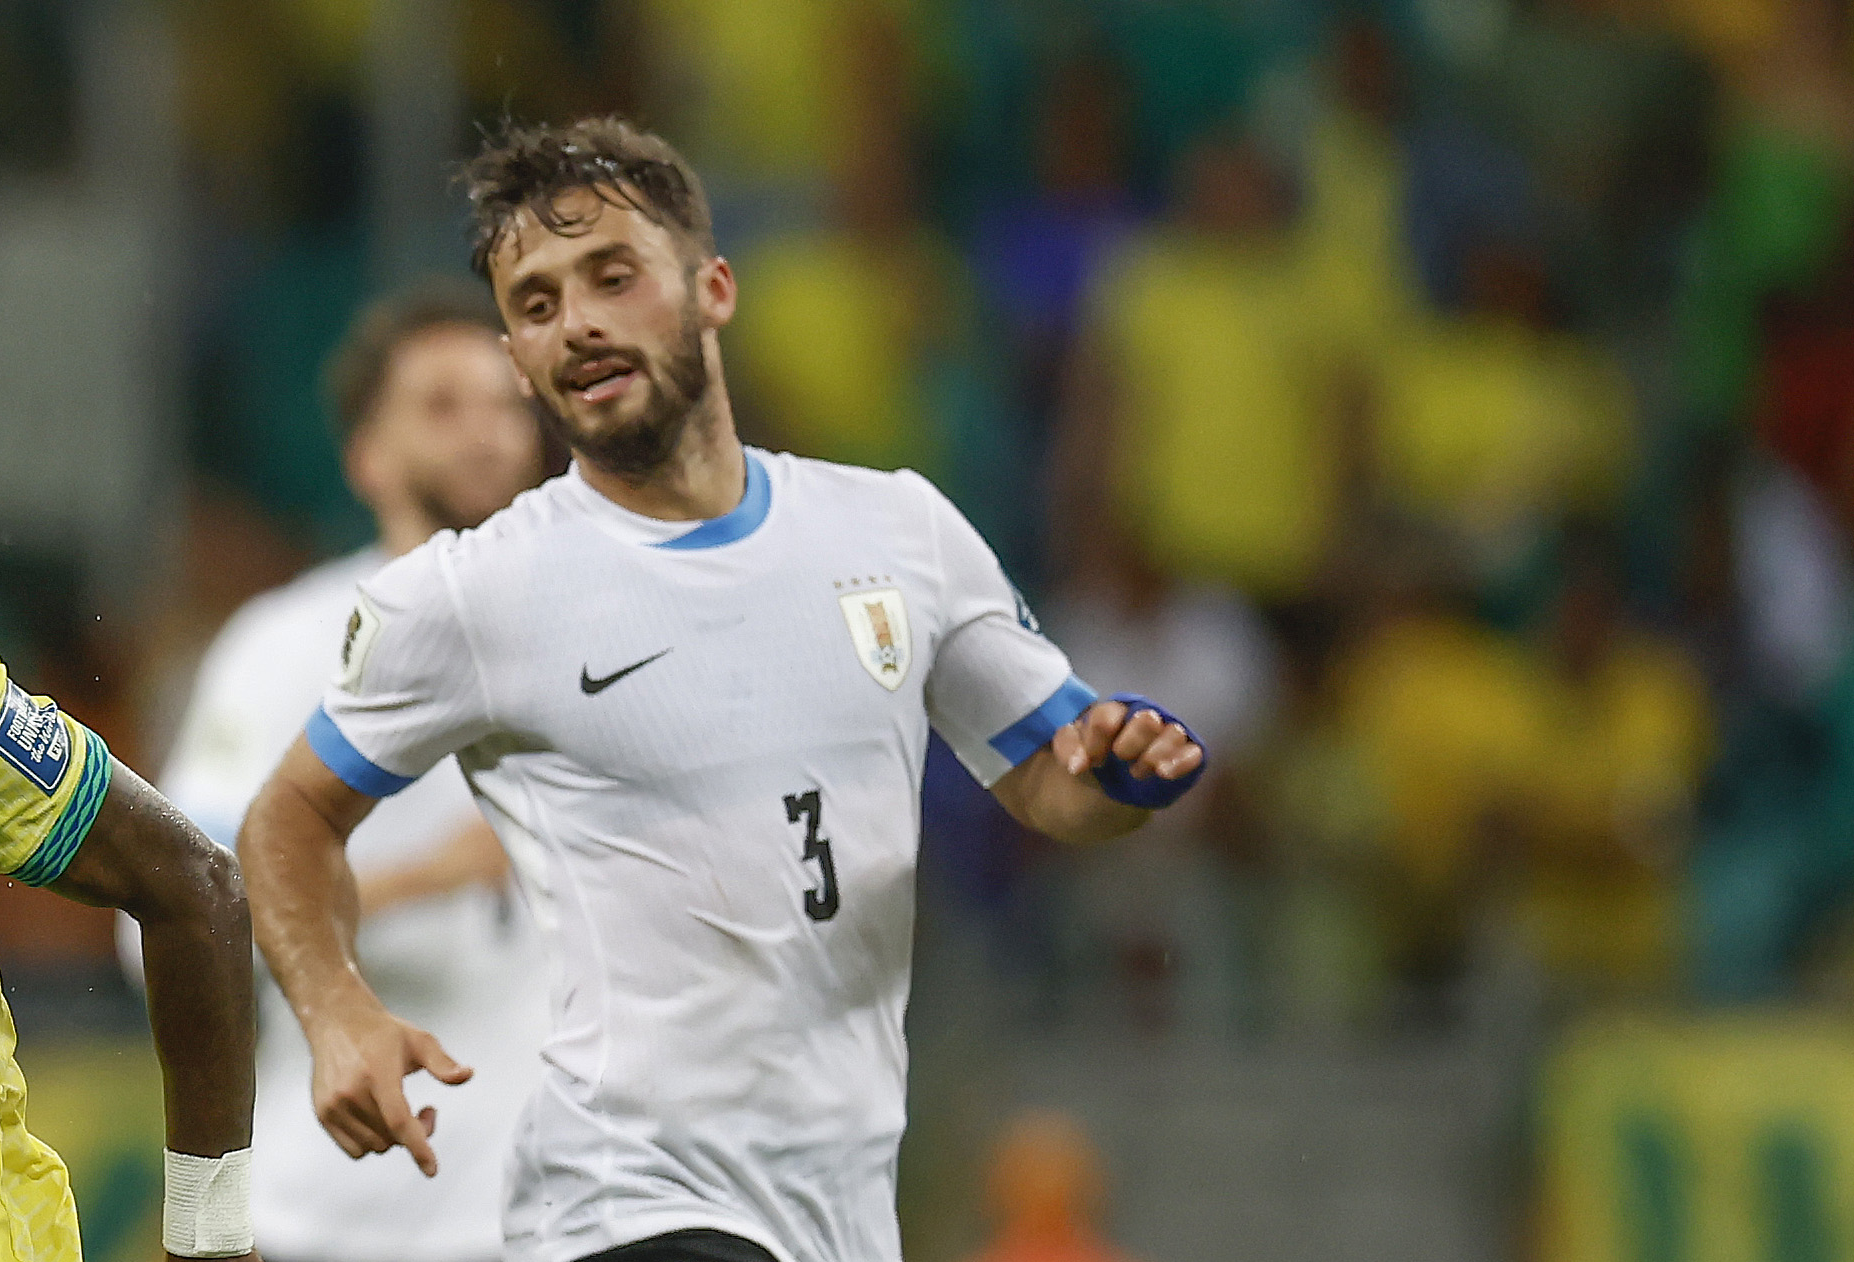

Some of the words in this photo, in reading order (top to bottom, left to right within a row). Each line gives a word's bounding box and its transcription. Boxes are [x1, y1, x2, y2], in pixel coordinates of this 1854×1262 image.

[6, 703, 28, 742] FOOT
[30, 742, 46, 763] the
[782, 790, 840, 921] 3
